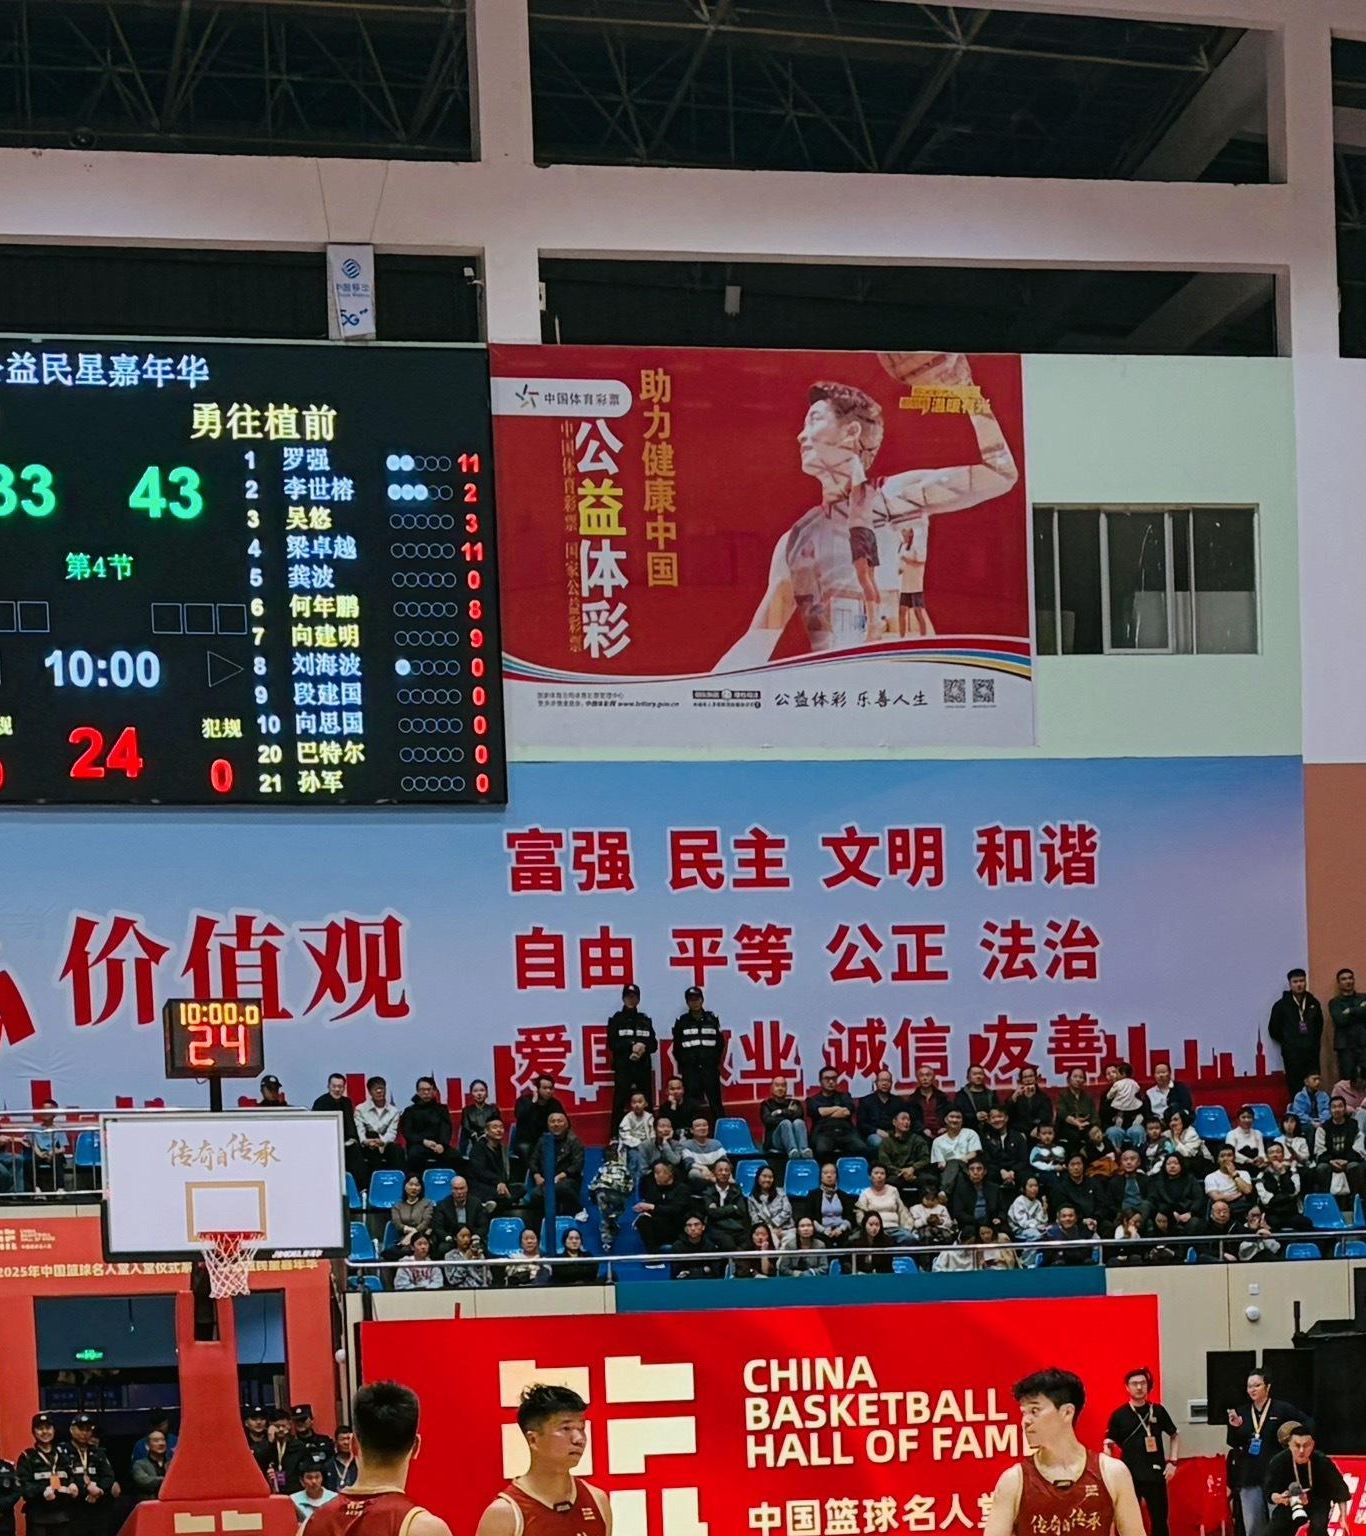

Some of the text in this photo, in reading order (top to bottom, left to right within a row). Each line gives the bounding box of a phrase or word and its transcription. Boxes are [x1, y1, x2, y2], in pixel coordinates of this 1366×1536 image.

[544, 392, 620, 406] 中国体育彩票
[190, 402, 338, 441] 勇往植前
[244, 446, 481, 474] 1 罗强 11
[245, 475, 479, 505] 2 李世榕 2
[639, 368, 678, 587] 助力健康中国
[128, 465, 205, 521] 43
[247, 505, 480, 535] 3 吴悠 3
[247, 533, 485, 563] 4 梁卓越 11
[576, 418, 631, 659] 公益体彩
[65, 551, 134, 581] 第4节
[249, 567, 264, 588] 5
[467, 570, 483, 590] 0
[250, 593, 484, 621] 6 何年鹏 8
[251, 622, 485, 649] 7 向建明 9
[44, 649, 161, 689] 10:00
[253, 651, 486, 680] 8 刘海波 0
[254, 680, 488, 710] 9 段建国 0
[774, 690, 847, 708] 公益体彩
[855, 690, 929, 708] 乐善人生
[201, 717, 243, 739] 犯规
[256, 709, 489, 737] 10 向思国 0
[68, 725, 146, 781] 24
[209, 758, 235, 795] 0
[257, 739, 490, 765] 20 巴特尔 0
[258, 769, 491, 794] 21 孙军 0
[505, 822, 1098, 893] 富强 民主 文明 和谐
[514, 919, 1100, 990] 自由 平等 公正 法治
[180, 1002, 259, 1025] 10:00.0
[188, 1025, 247, 1066] 24
[828, 1018, 951, 1079] 诚信
[983, 1014, 1103, 1075] 友善
[167, 1133, 281, 1171] 传奇自传承
[744, 1356, 877, 1394] CHINA
[746, 1389, 1009, 1433] BASKETBALL
[747, 1432, 854, 1469] HALL
[866, 1429, 921, 1463] OF
